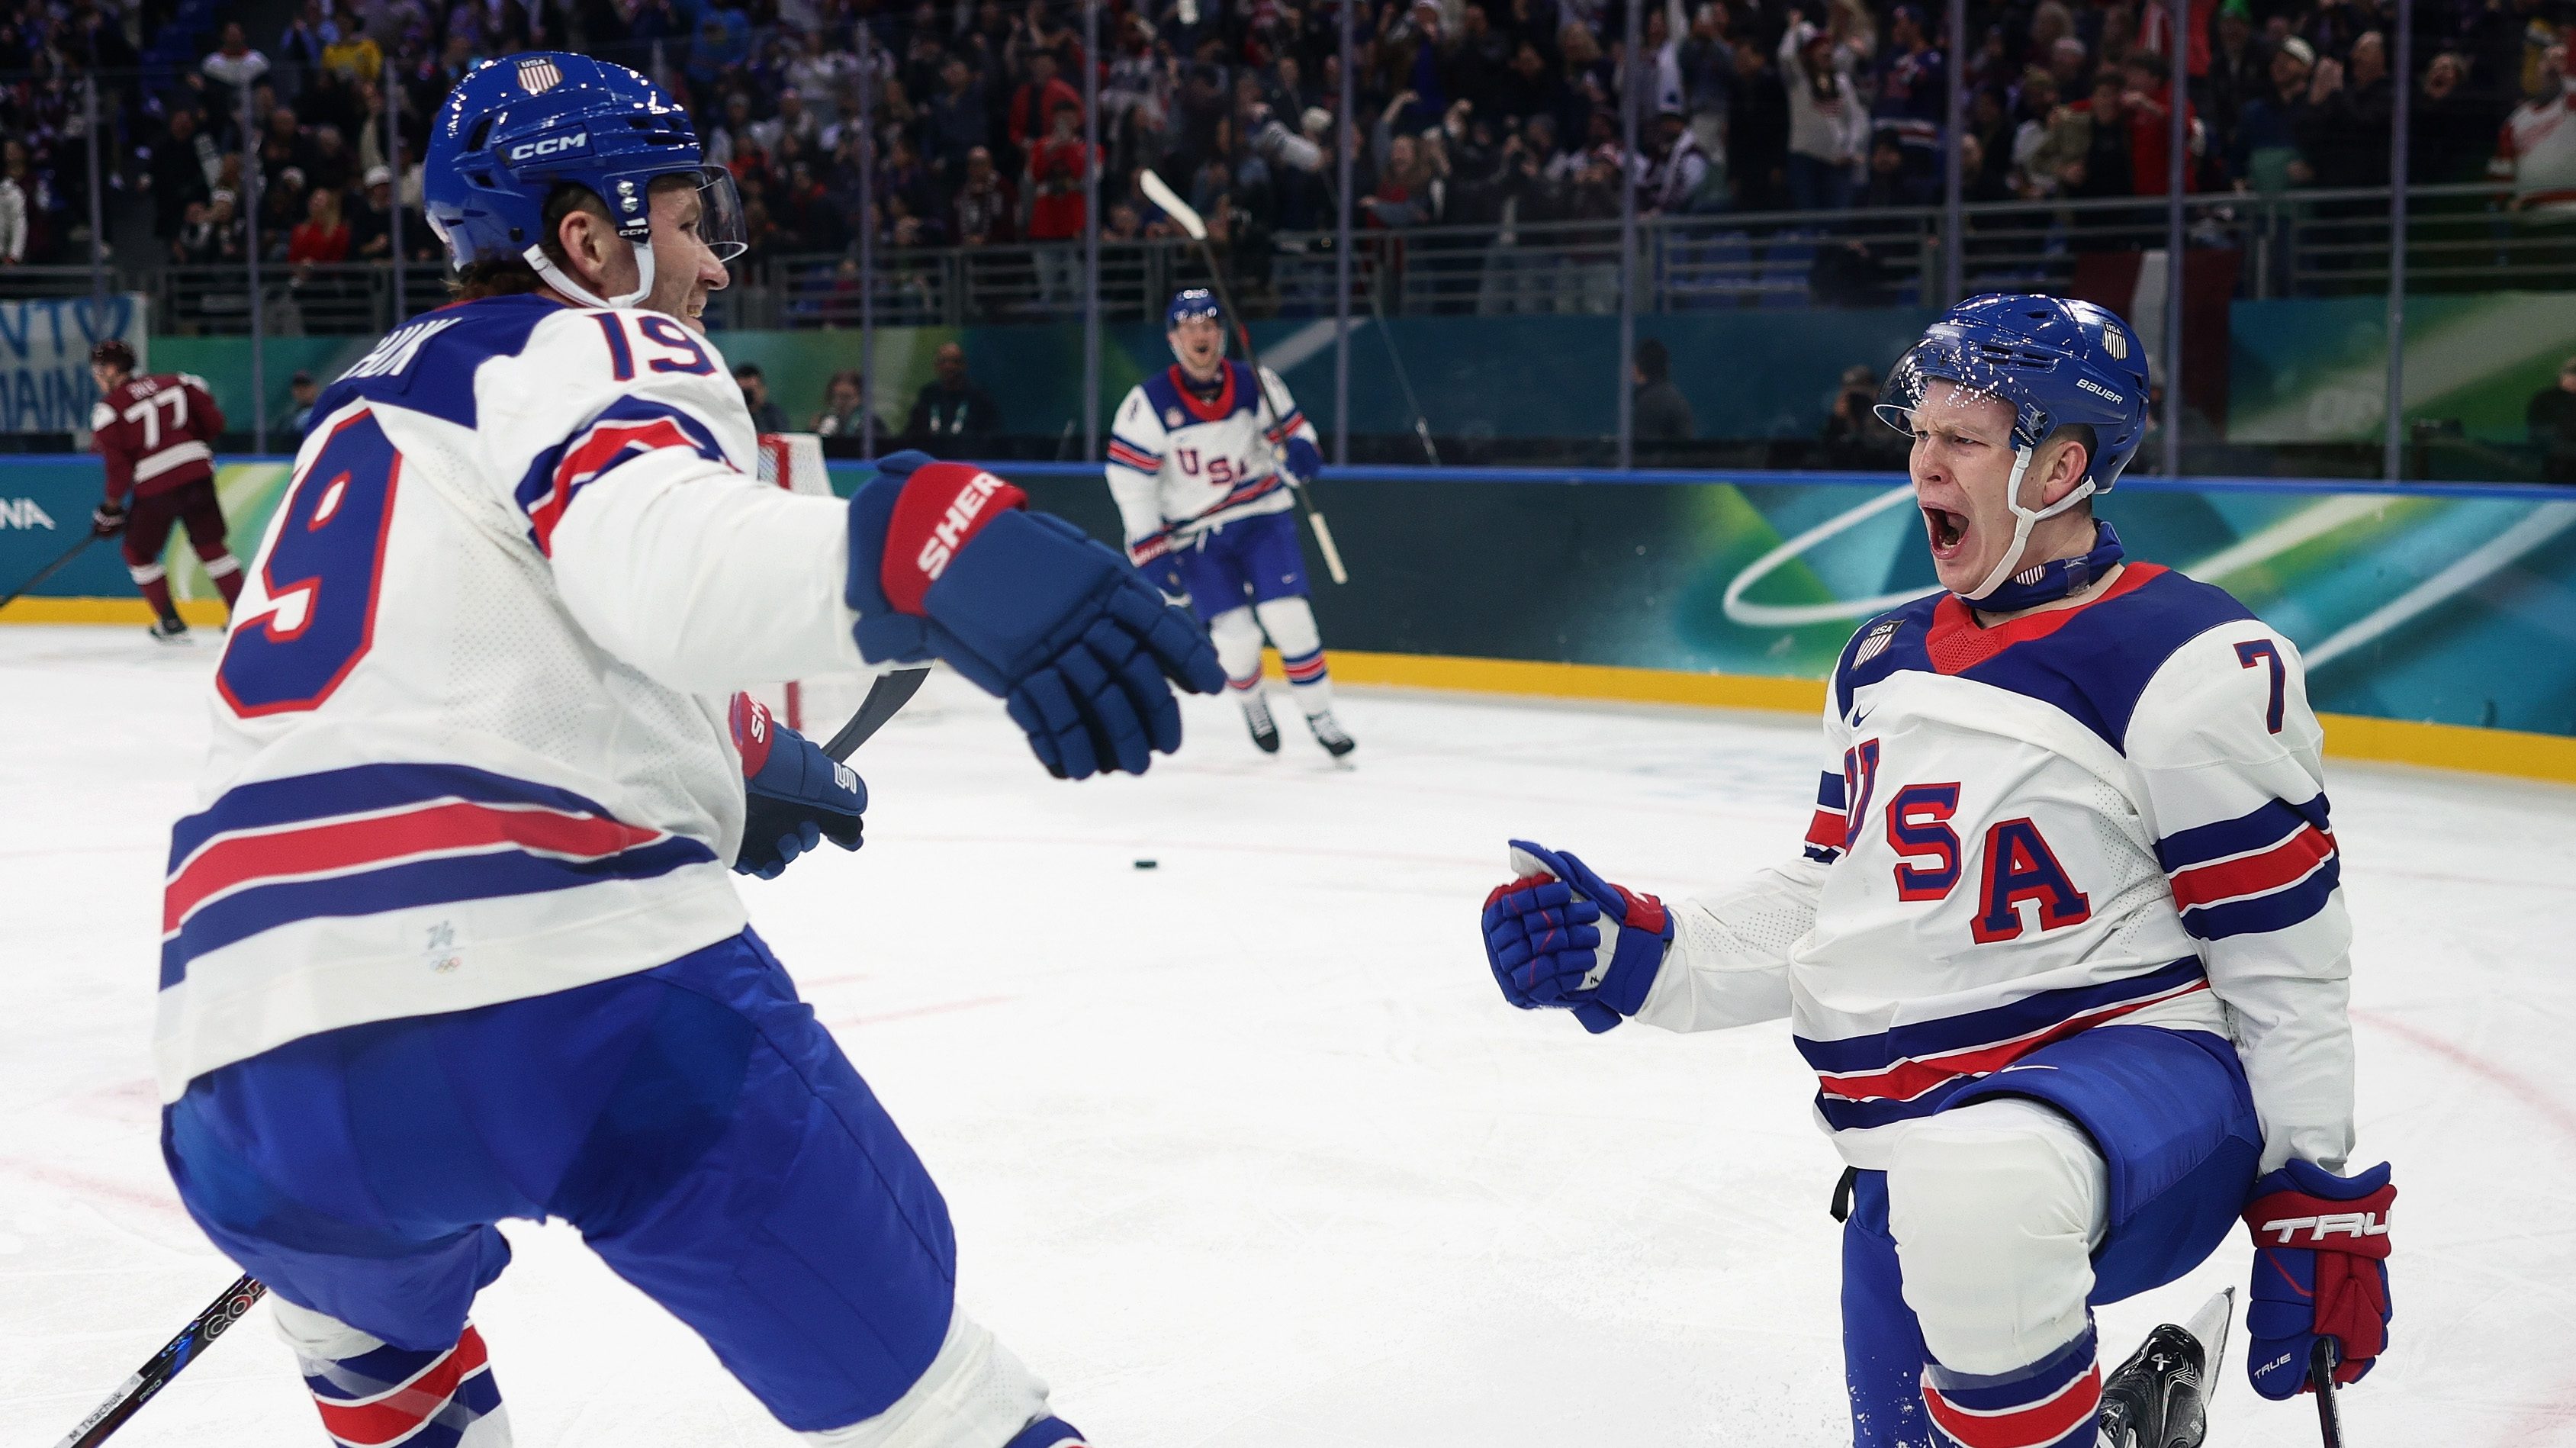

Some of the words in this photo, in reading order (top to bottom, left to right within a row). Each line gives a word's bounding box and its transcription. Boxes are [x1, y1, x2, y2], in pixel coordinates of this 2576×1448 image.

[520, 58, 547, 69] USA
[510, 132, 587, 160] CCM
[619, 227, 649, 237] CCM
[584, 311, 717, 382] 19
[2105, 323, 2122, 335] USA
[124, 385, 188, 449] 77
[918, 471, 1007, 581] SHER
[216, 407, 403, 719] 9
[1870, 623, 1893, 637] USA
[2233, 639, 2286, 735] 7
[1844, 737, 2092, 945] USA
[2261, 1209, 2392, 1244] TRU
[2254, 1352, 2291, 1379] TRUE
[79, 1391, 124, 1430] Tkachuk
